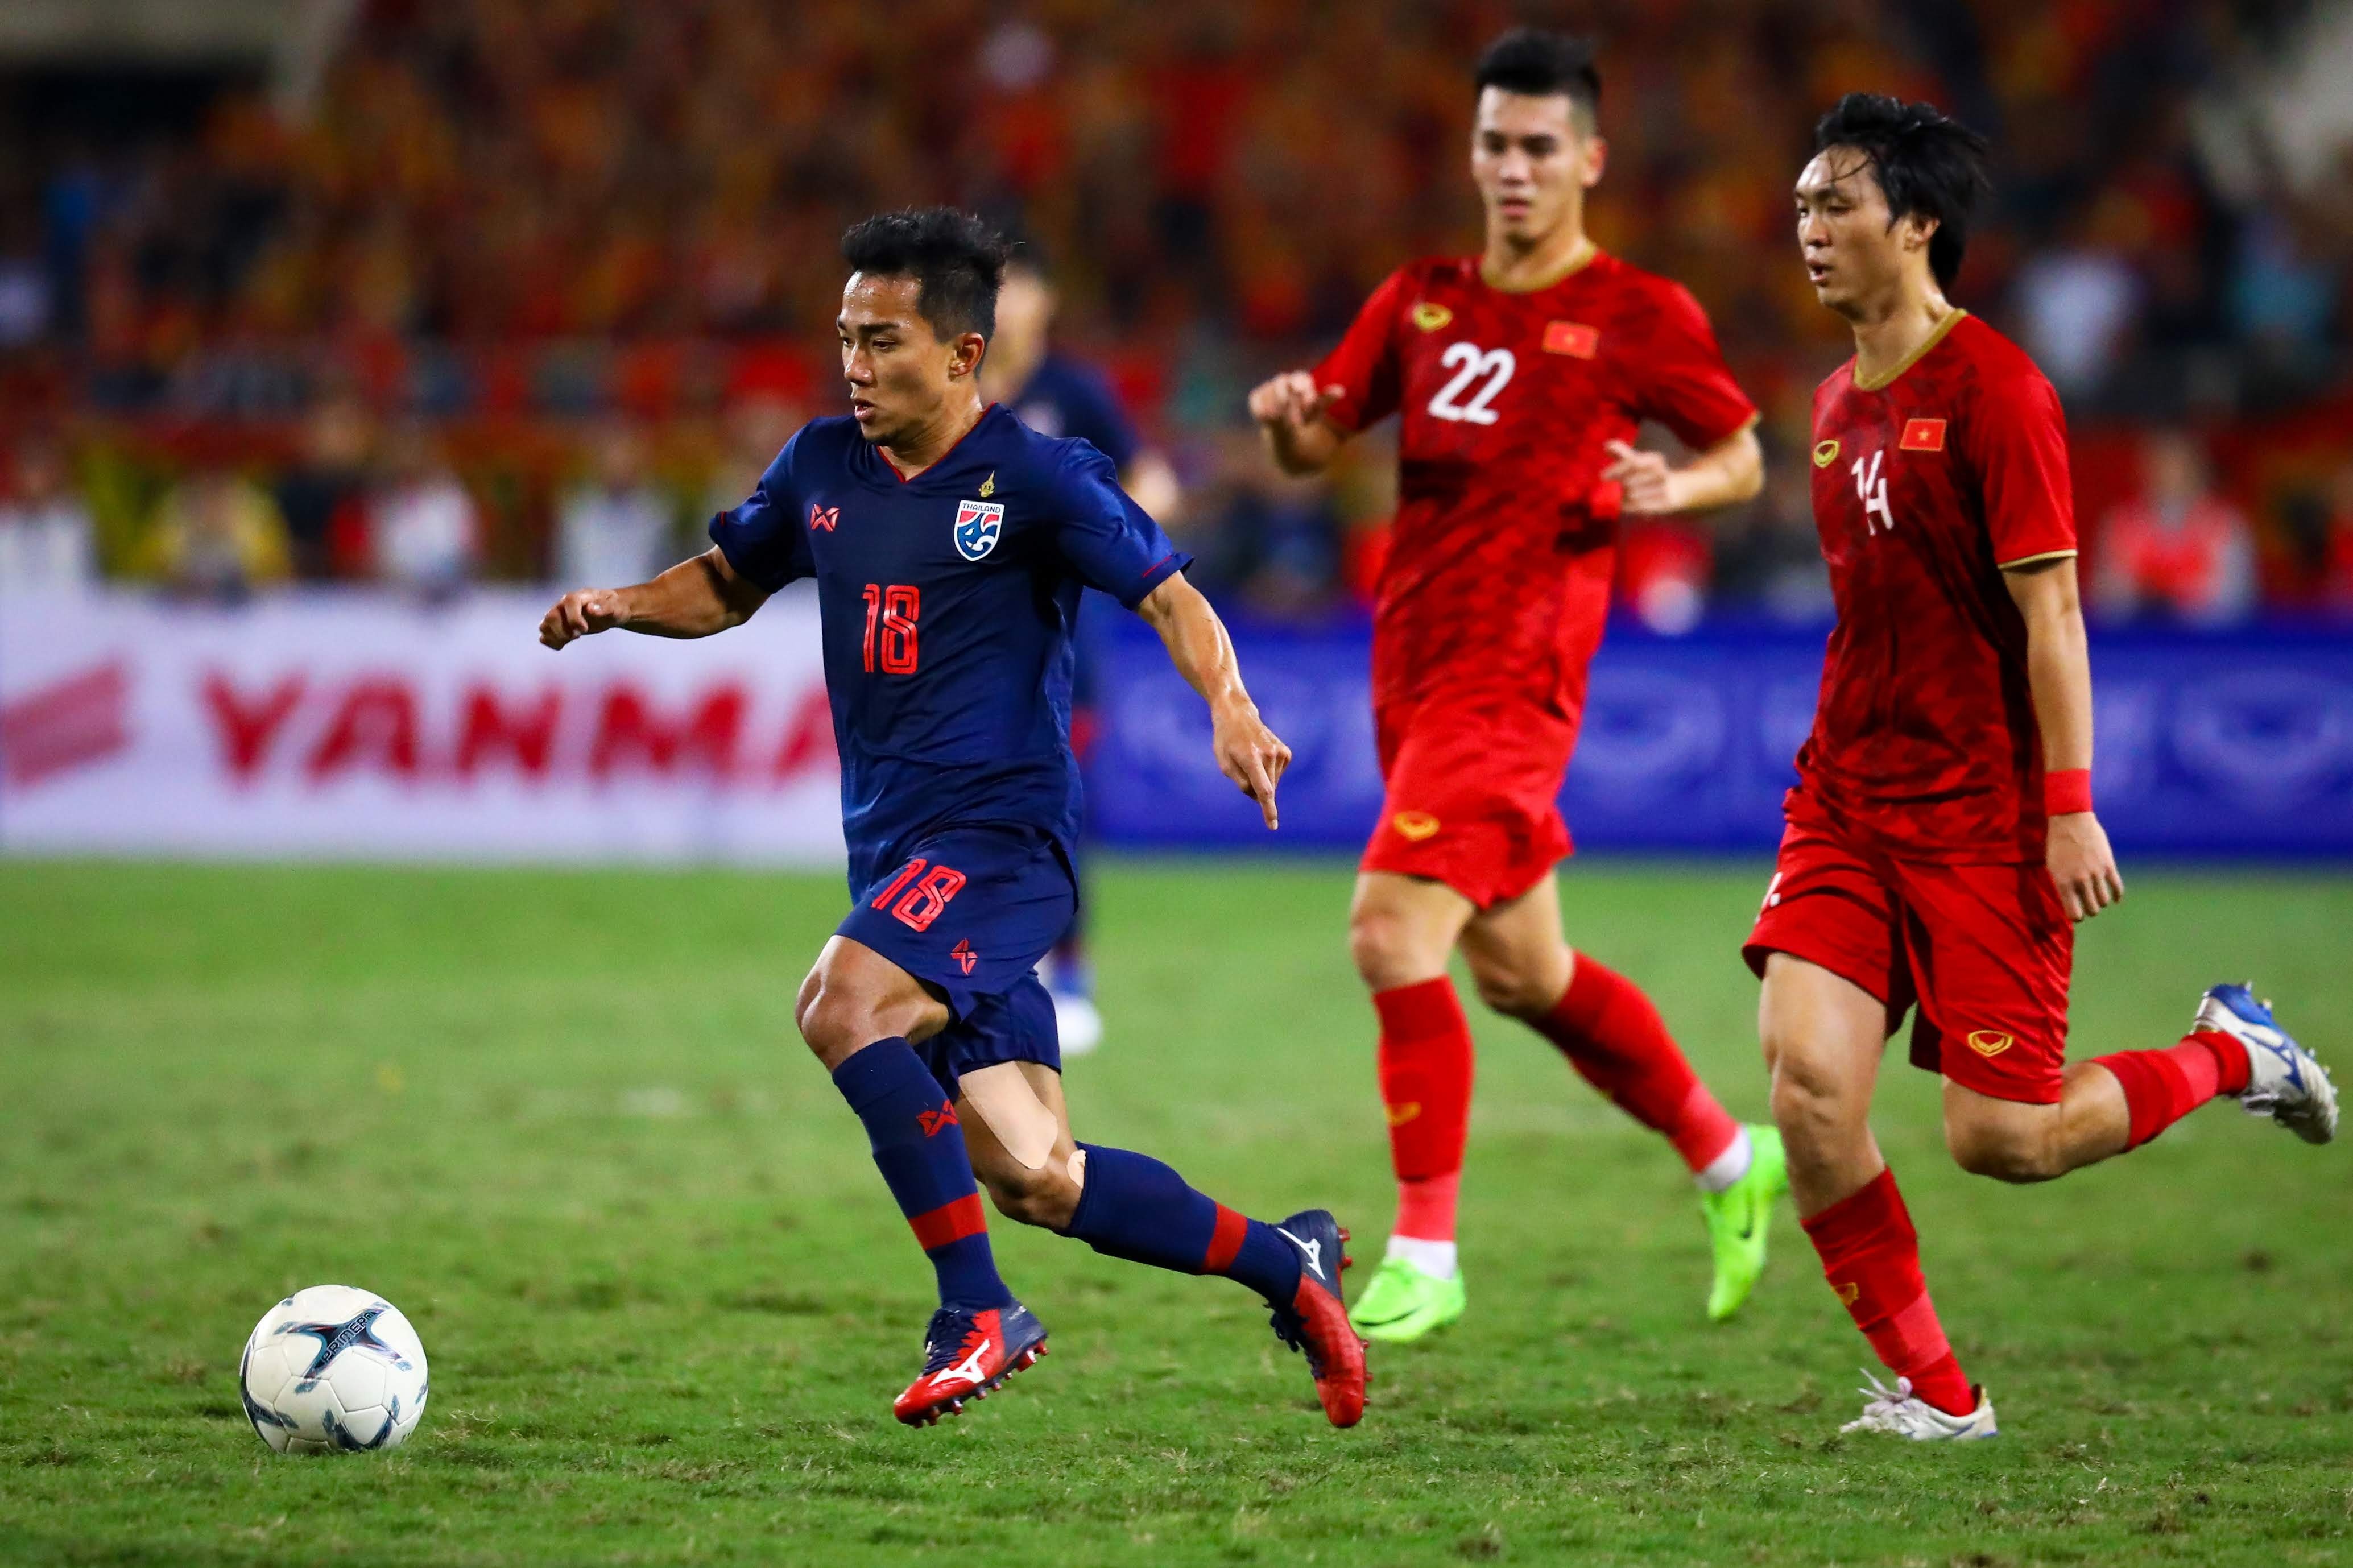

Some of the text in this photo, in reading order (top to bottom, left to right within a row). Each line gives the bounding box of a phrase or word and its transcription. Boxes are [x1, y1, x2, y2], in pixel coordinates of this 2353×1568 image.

[1428, 341, 1516, 425] 22
[962, 503, 1001, 514] THAILAND
[1851, 450, 1894, 536] 14
[862, 584, 920, 674] 18
[870, 858, 967, 932] 18
